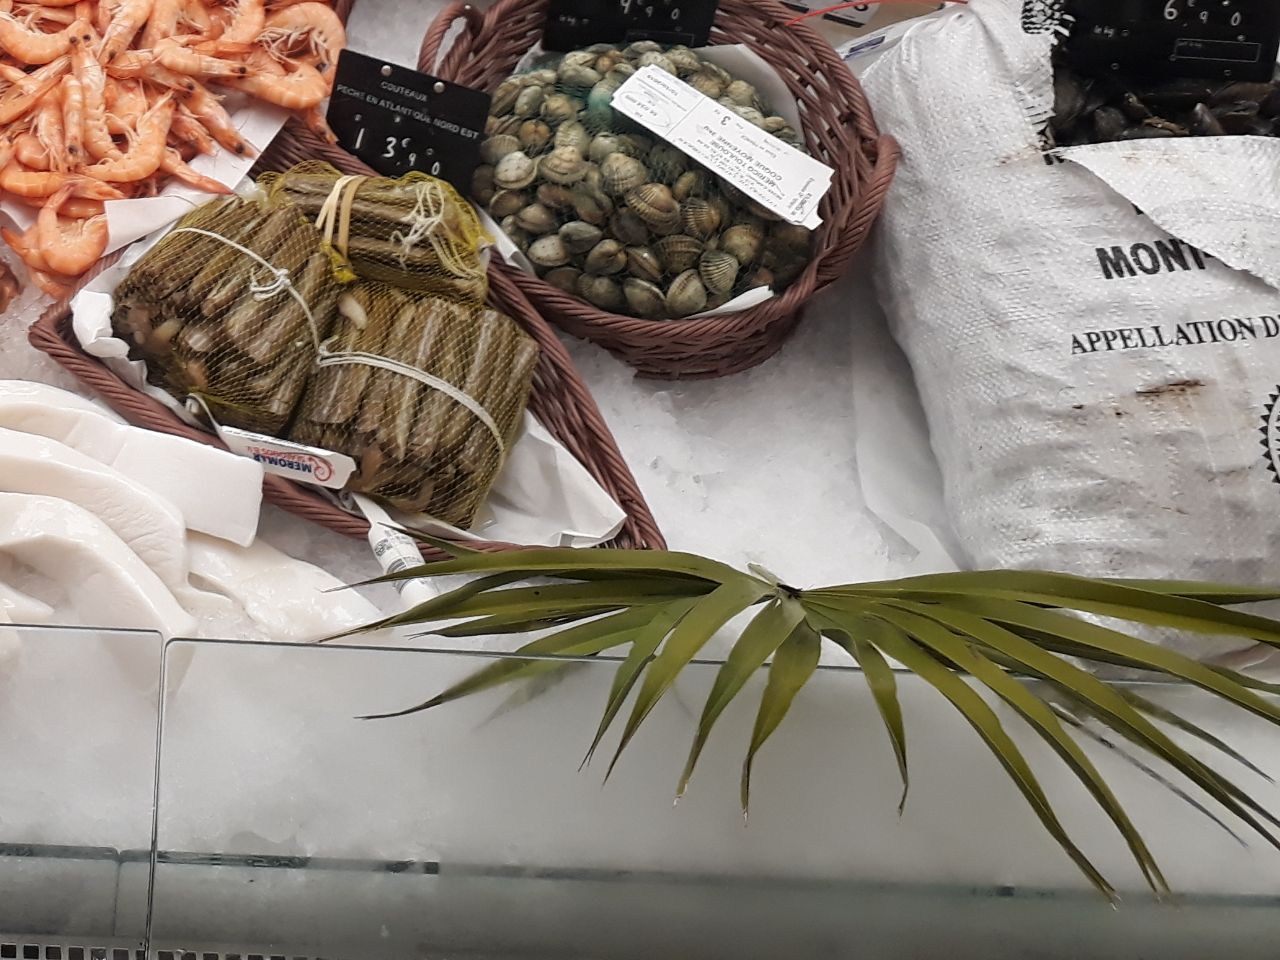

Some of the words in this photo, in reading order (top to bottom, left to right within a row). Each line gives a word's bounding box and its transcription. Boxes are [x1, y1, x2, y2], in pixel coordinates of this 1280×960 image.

[380, 81, 428, 102] COUTEAUX
[433, 118, 459, 133] NORD
[460, 127, 480, 140] EST
[1071, 314, 1257, 354] APPELLATION
